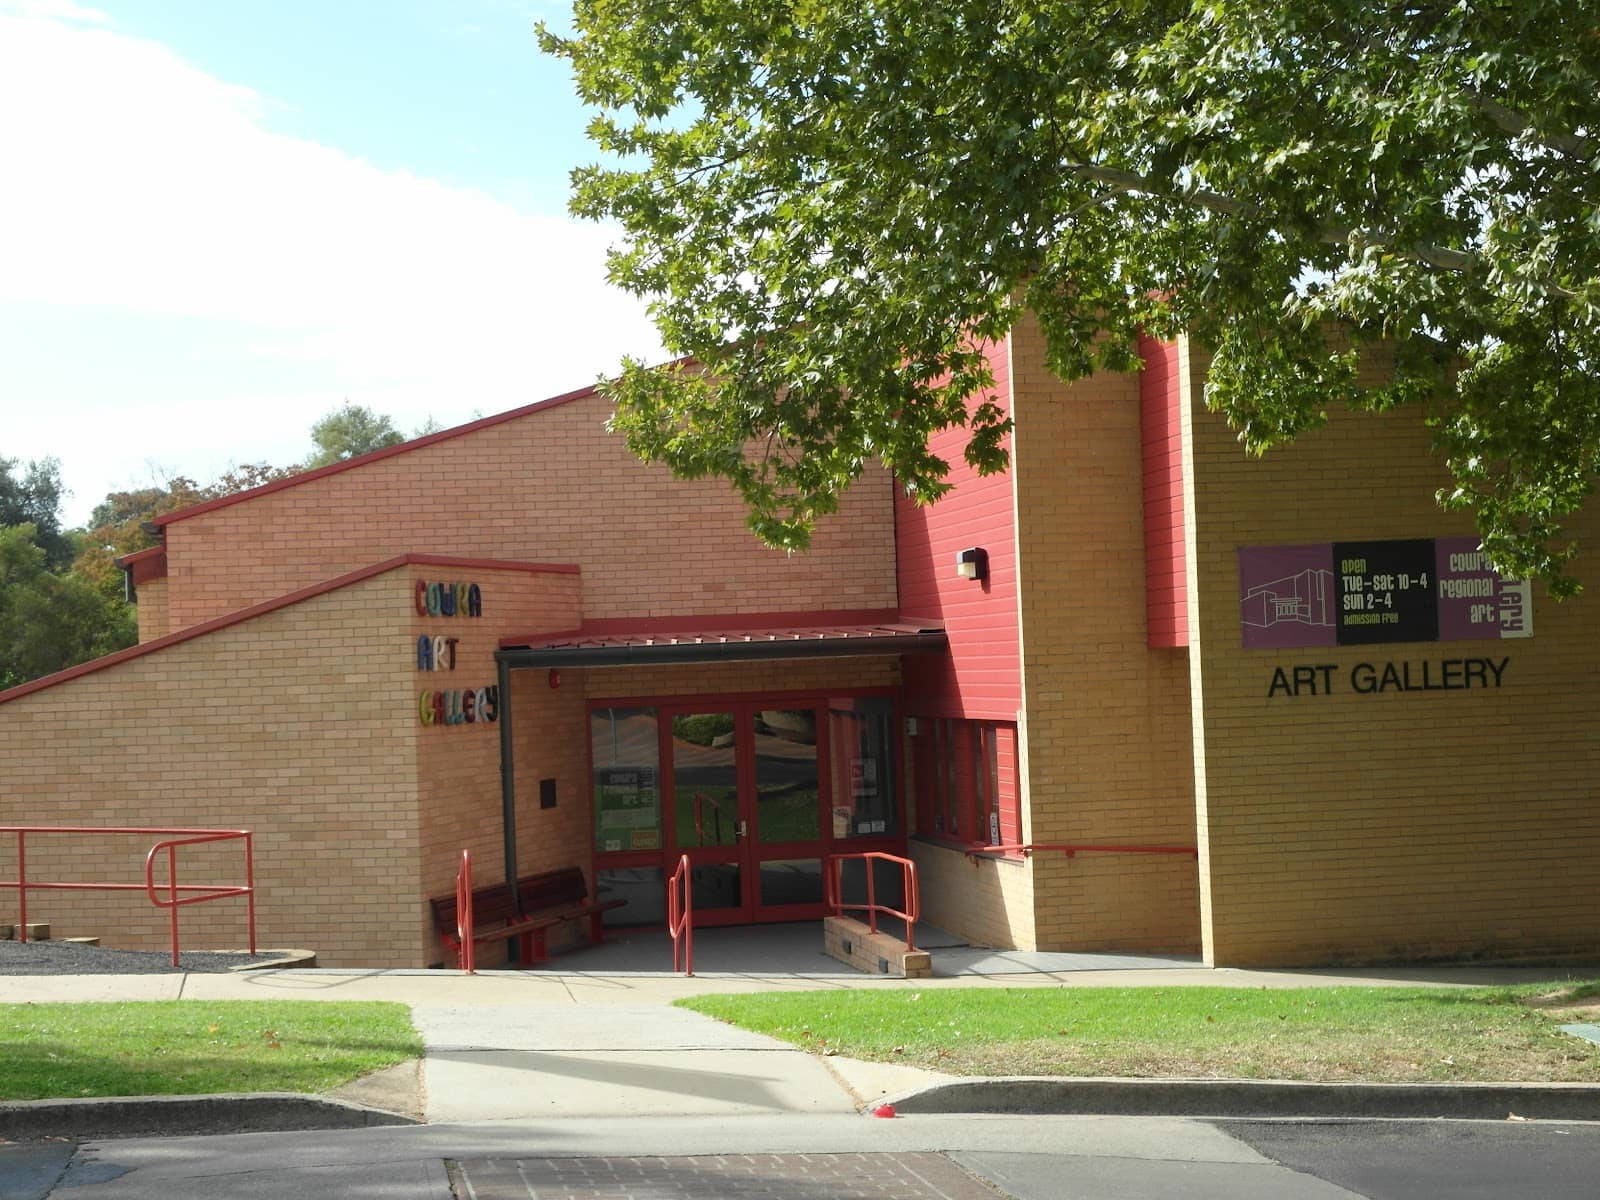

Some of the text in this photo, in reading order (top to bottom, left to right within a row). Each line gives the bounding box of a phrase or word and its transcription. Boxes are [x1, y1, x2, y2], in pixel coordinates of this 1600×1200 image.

[1341, 558, 1366, 574] open
[415, 579, 480, 616] COWRA
[1439, 577, 1494, 599] regional
[1343, 614, 1380, 626] admission
[1470, 603, 1495, 624] art
[417, 635, 459, 671] ART
[1268, 656, 1509, 697] ART GALLERY
[419, 685, 498, 726] GALLERY
